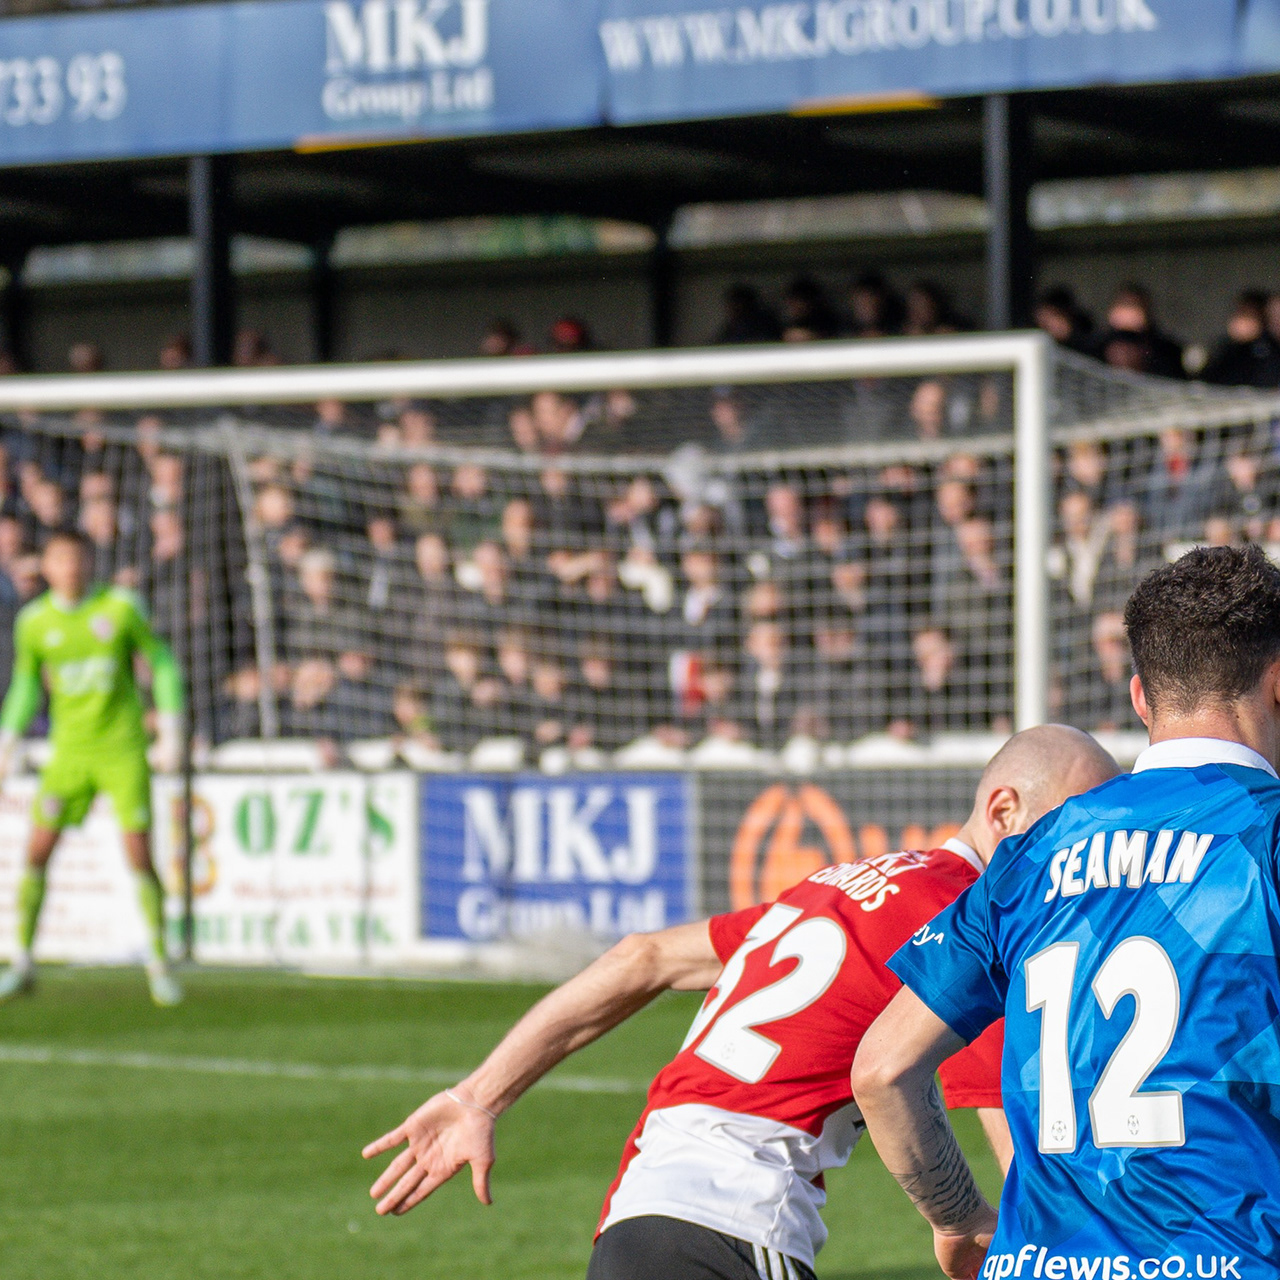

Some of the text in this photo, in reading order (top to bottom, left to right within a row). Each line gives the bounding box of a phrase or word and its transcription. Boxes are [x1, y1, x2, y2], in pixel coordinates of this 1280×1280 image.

[324, 0, 489, 74] MKJ
[463, 786, 657, 885] MKJ
[1045, 829, 1214, 903] SEAMAN
[1025, 935, 1185, 1154] 12
